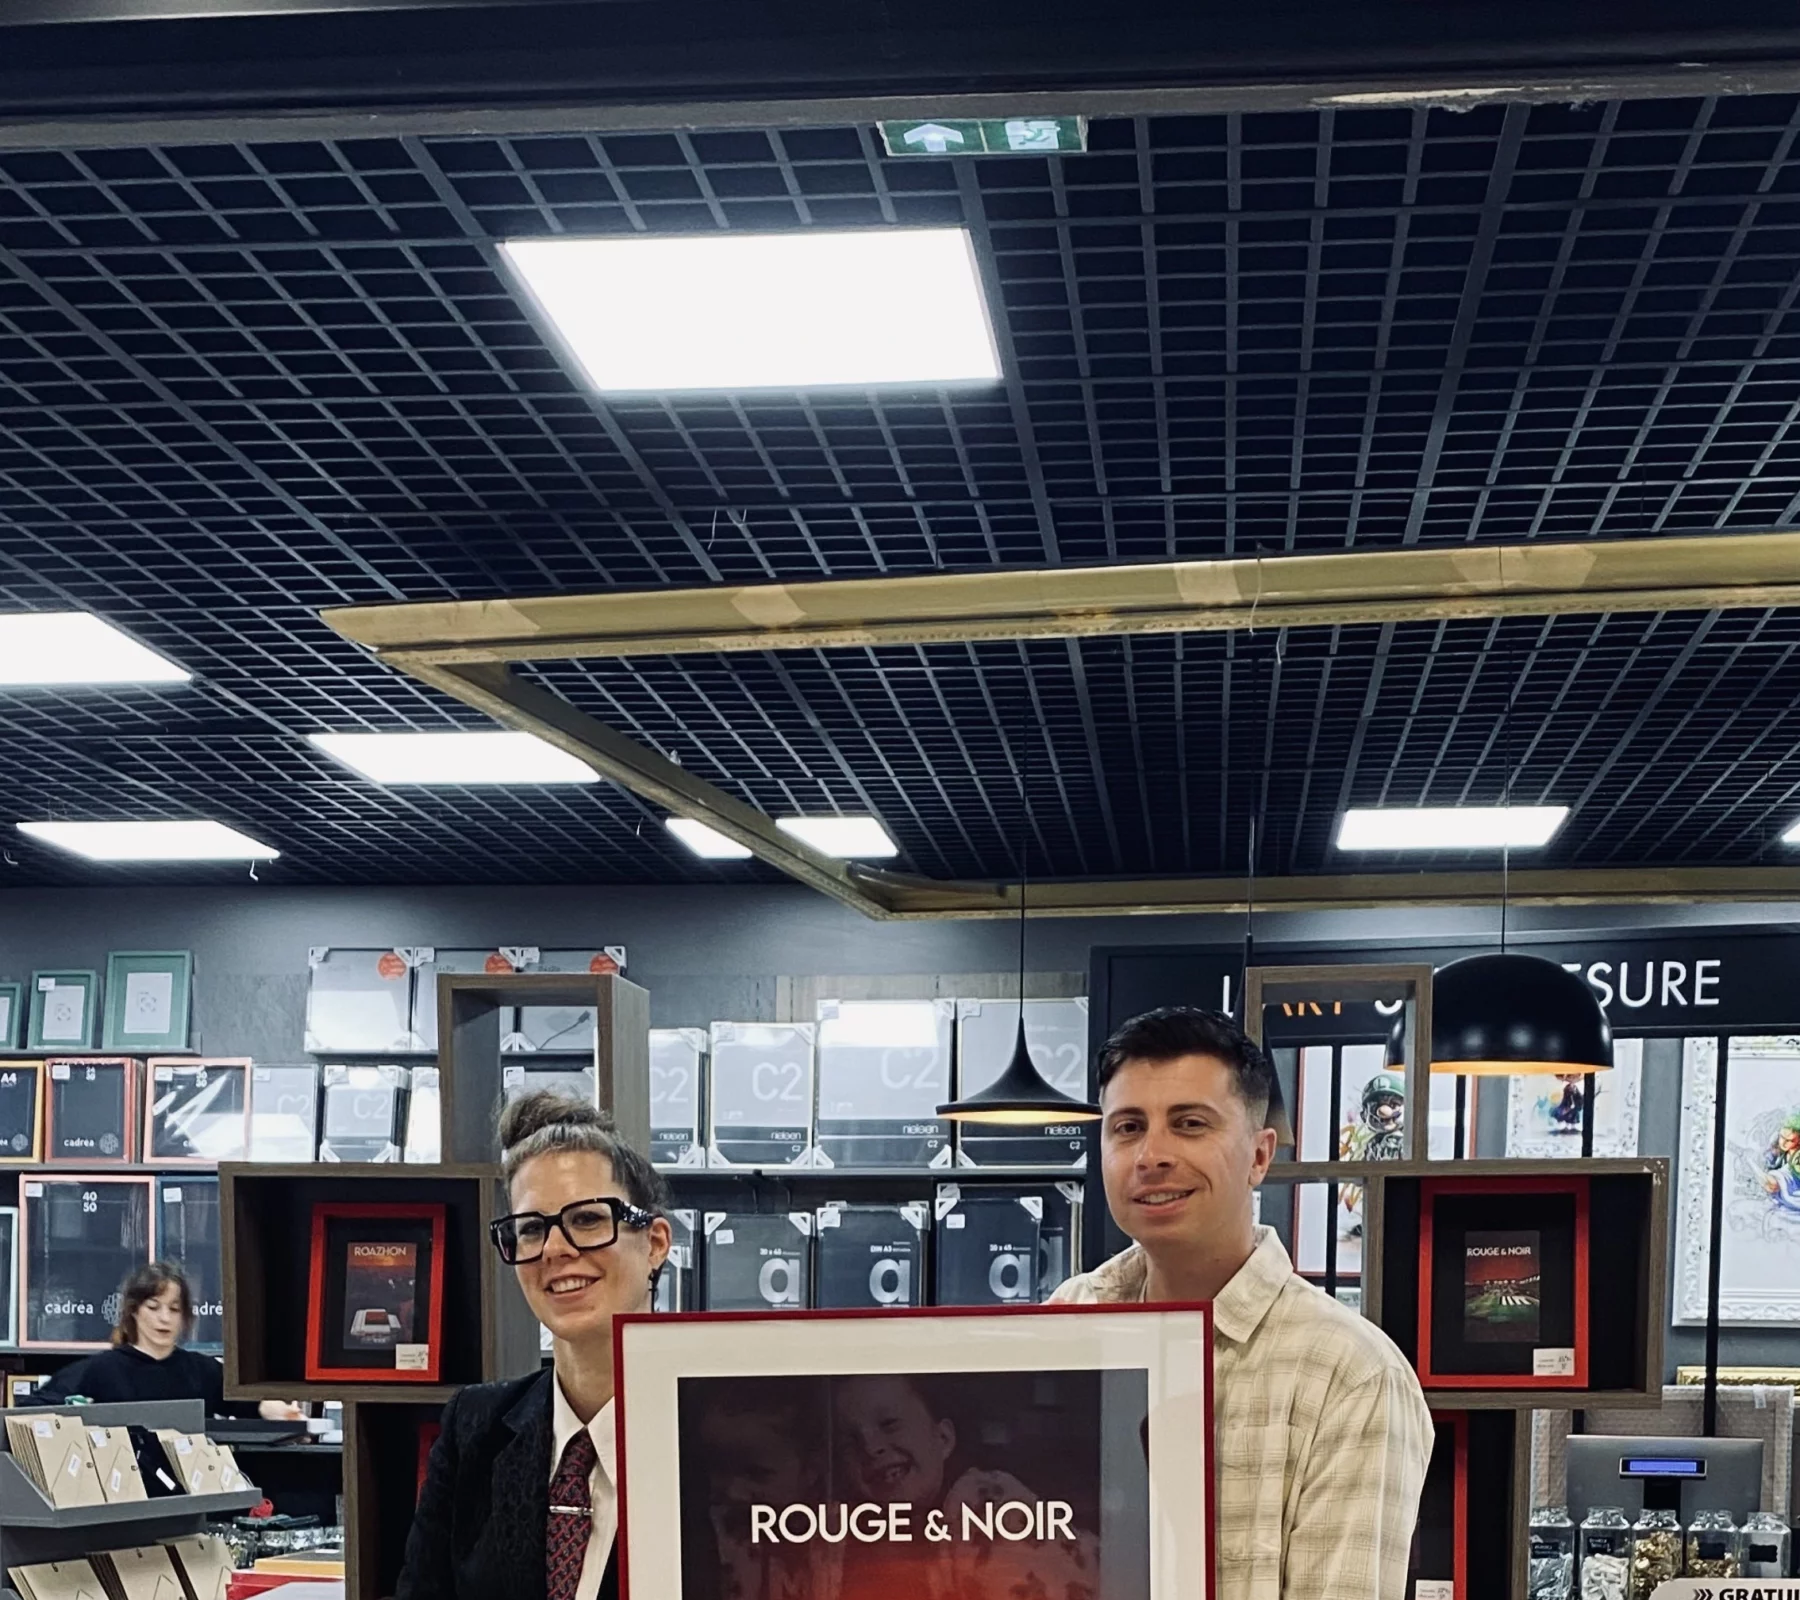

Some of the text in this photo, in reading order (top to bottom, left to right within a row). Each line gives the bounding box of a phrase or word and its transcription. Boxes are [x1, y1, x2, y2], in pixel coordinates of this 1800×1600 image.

[1562, 959, 1722, 1008] SURE
[1, 1073, 17, 1083] A4
[880, 1045, 940, 1090] C2
[752, 1061, 803, 1101] C2
[353, 1093, 389, 1119] C2
[927, 1140, 938, 1148] C2
[1069, 1141, 1081, 1150] C2
[82, 1191, 98, 1201] 40
[83, 1202, 97, 1212] 50
[354, 1246, 407, 1257] ROAZHON
[1466, 1247, 1500, 1257] ROUGE
[1508, 1246, 1532, 1256] NOIR
[758, 1257, 800, 1304] a
[869, 1258, 911, 1304] a
[988, 1253, 1031, 1298] a
[751, 1500, 1076, 1543] ROUGE & NOIR
